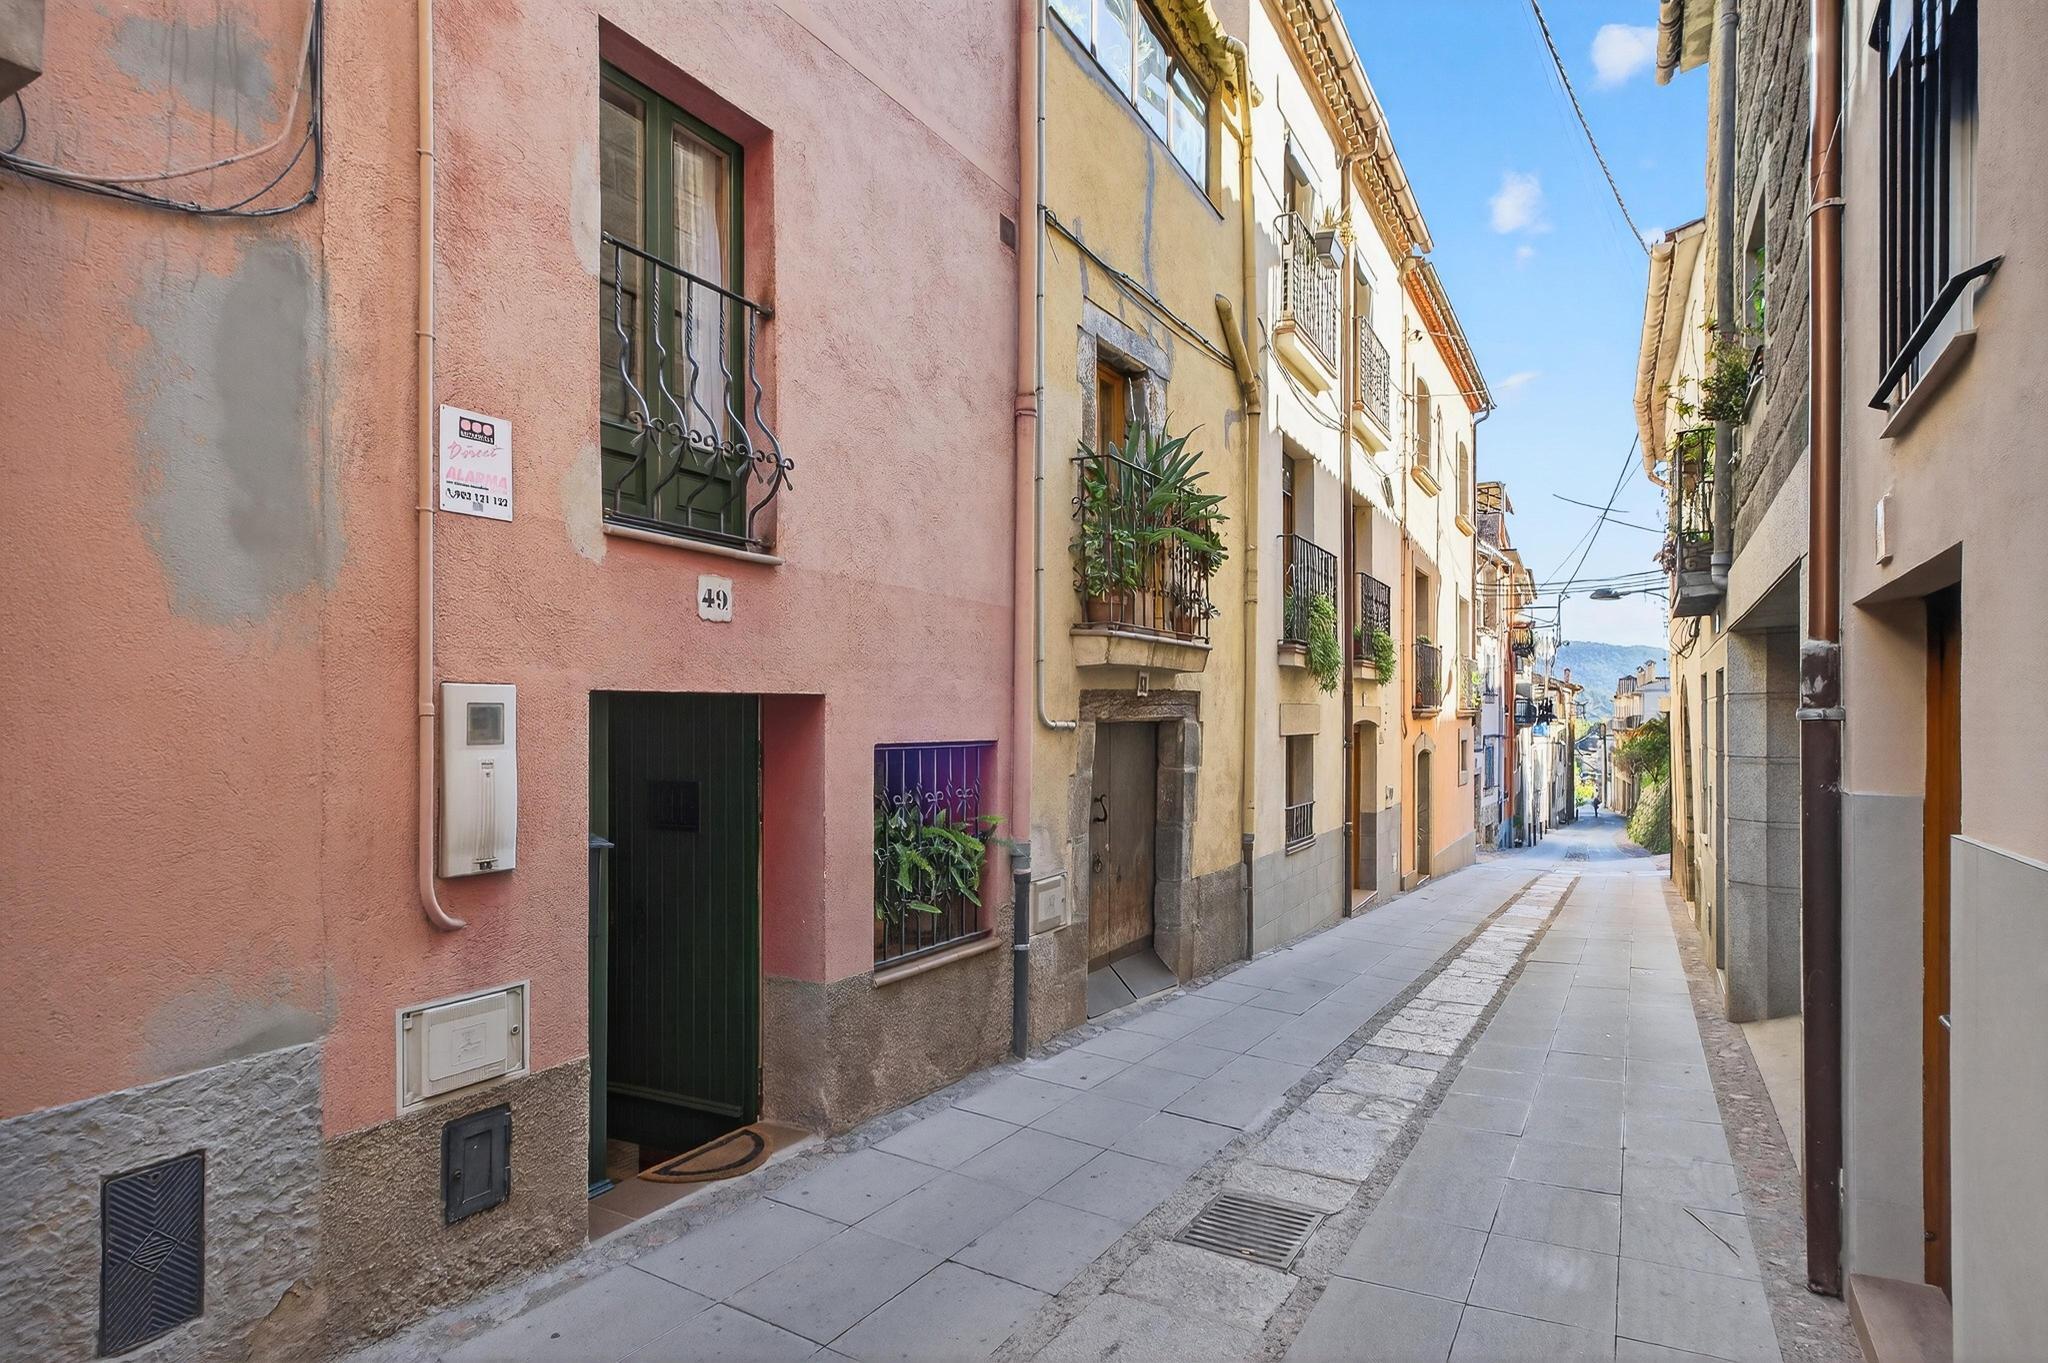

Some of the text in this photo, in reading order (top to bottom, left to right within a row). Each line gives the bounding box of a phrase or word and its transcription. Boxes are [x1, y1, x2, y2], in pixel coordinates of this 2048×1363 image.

[446, 466, 508, 489] ALARMA
[475, 493, 489, 504] 121
[702, 588, 728, 610] 49
